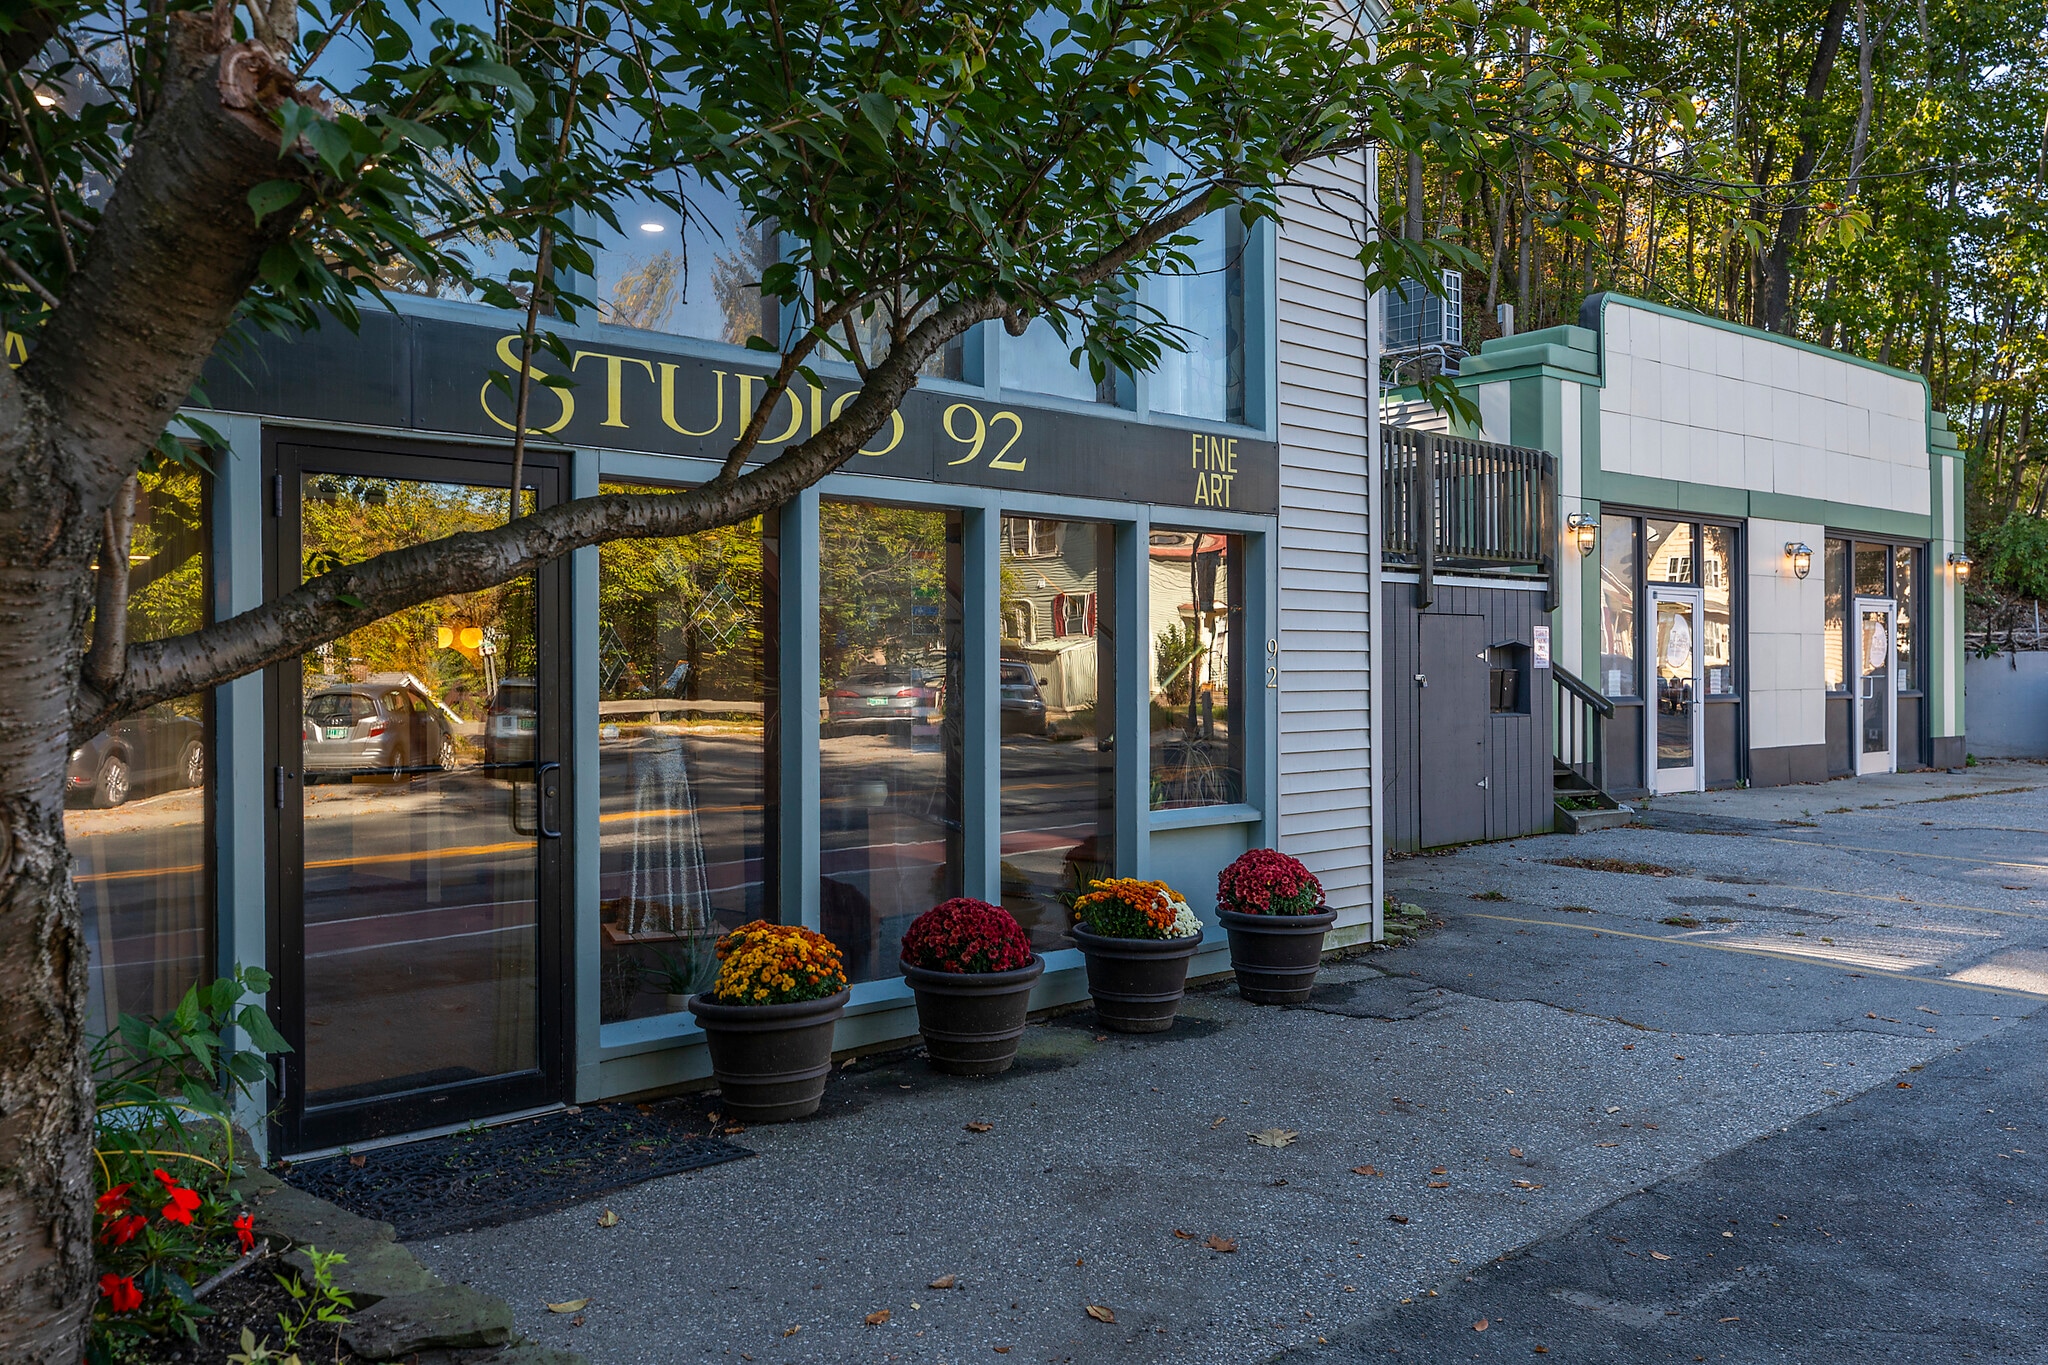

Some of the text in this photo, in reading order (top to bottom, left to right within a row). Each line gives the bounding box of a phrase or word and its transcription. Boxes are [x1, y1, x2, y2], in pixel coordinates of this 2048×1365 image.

[480, 334, 1027, 472] STUDIO 92
[1192, 433, 1238, 474] FINE
[1194, 471, 1234, 508] ART
